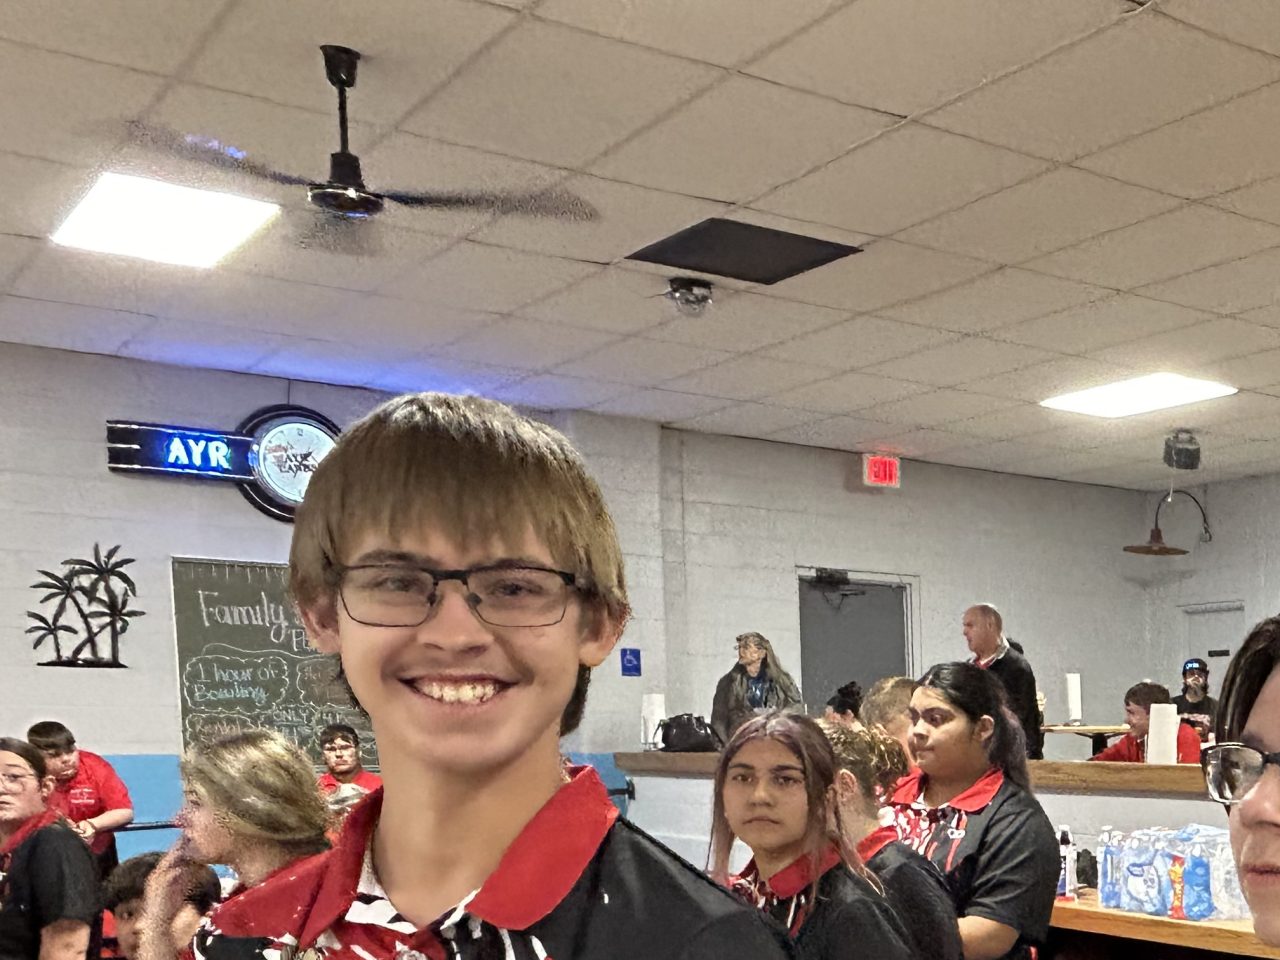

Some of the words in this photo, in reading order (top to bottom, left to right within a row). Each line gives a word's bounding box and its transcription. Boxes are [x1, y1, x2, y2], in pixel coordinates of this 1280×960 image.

[167, 437, 232, 470] AYR
[198, 590, 289, 643] Family
[197, 663, 211, 682] 1
[213, 663, 253, 682] hour
